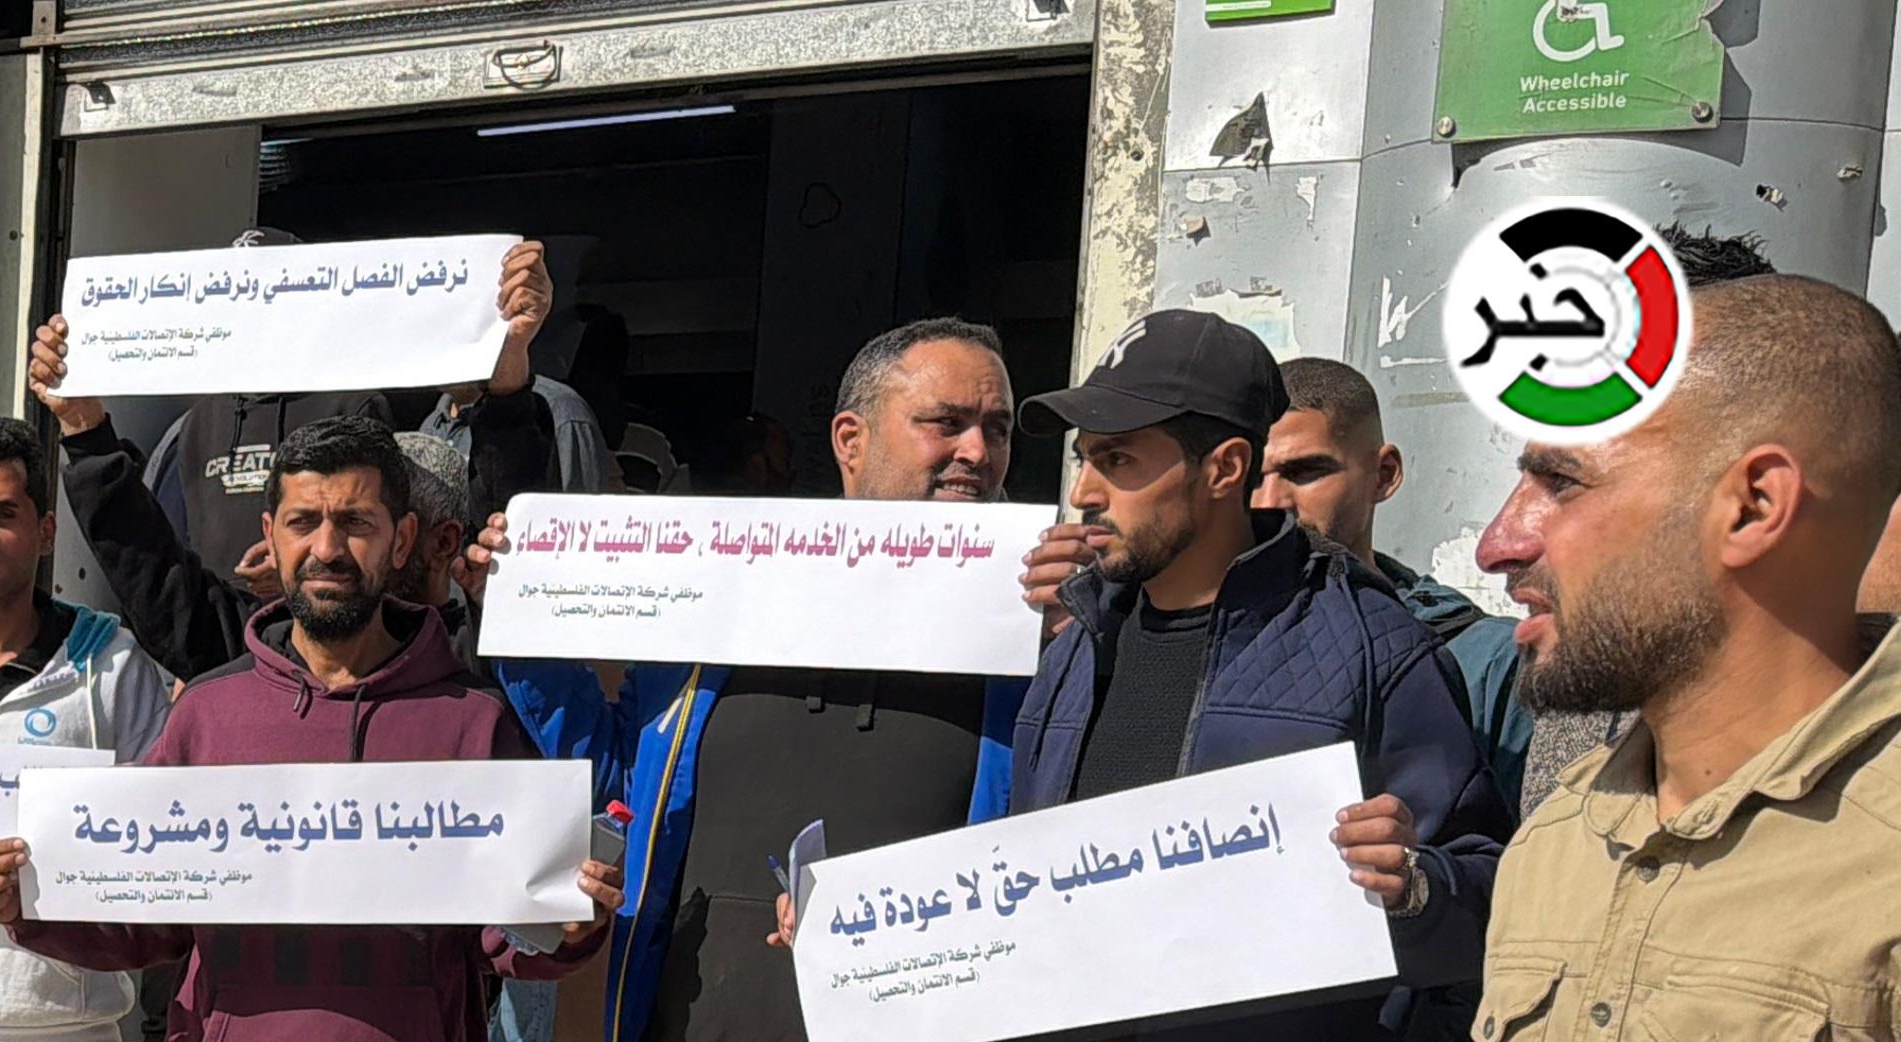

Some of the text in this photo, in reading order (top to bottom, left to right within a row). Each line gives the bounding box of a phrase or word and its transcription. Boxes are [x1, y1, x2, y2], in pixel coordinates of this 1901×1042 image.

[1520, 70, 1630, 92] Wheelchair
[1522, 92, 1627, 114] Accessible
[81, 258, 468, 307] نرفض الفصل التعسفي ونرفض إنكار الحقوق
[578, 519, 592, 552] لا
[593, 515, 653, 563] التثبيت
[655, 519, 694, 554] حقنا
[710, 521, 780, 565] المتواصلة
[784, 521, 847, 557] الخدمه
[847, 527, 875, 568] من
[880, 522, 934, 568] طويله
[937, 523, 995, 568] سنوات
[73, 799, 504, 854] مطالبنا قانونية ومشروعة
[1152, 801, 1284, 871] إنصافنا
[55, 872, 77, 886] جوال
[183, 869, 217, 885] شركة
[956, 869, 982, 911] لا
[1050, 842, 1144, 904] مطلب
[830, 892, 877, 947] فيه
[879, 886, 952, 932] عودة
[949, 947, 982, 963] شركة
[831, 973, 851, 989] جوال
